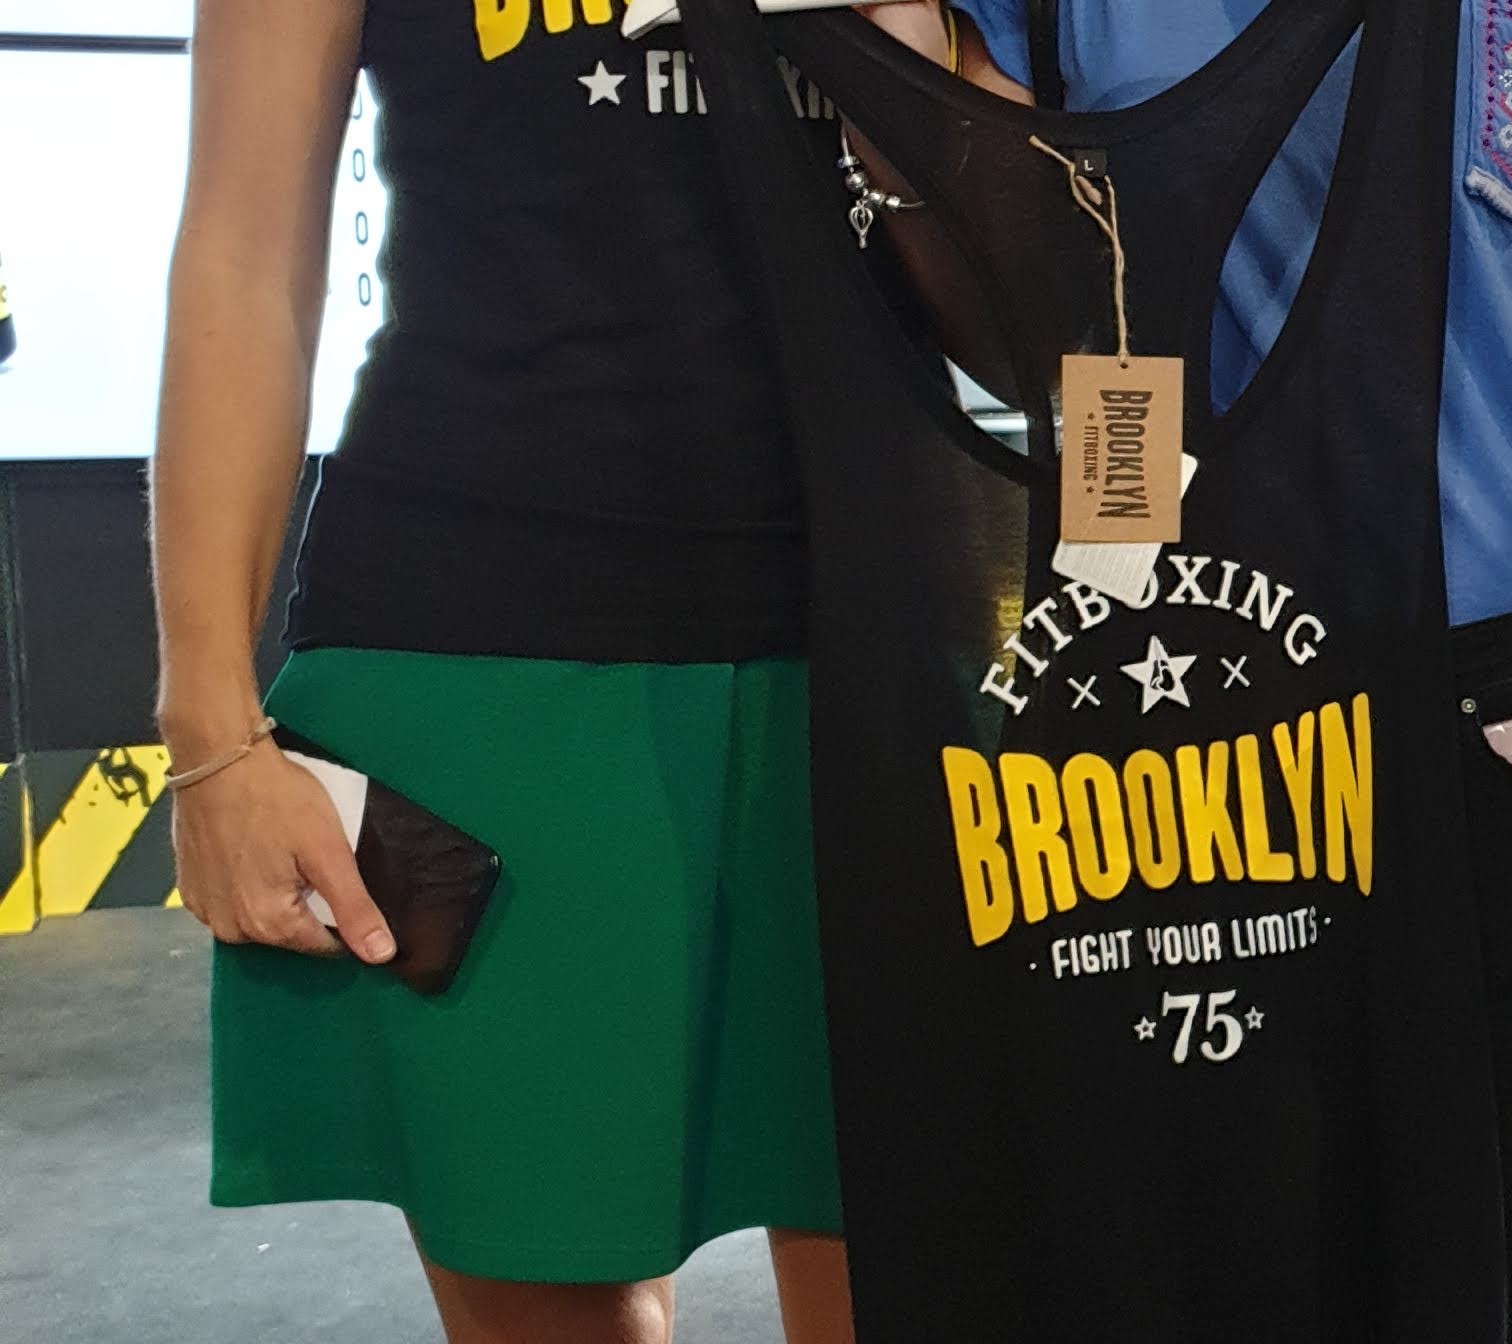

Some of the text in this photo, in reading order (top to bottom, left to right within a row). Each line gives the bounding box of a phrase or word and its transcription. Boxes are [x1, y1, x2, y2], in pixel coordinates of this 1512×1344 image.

[1084, 159, 1094, 172] L
[1083, 425, 1099, 481] FITBOXING
[1097, 389, 1153, 518] BROOKLYN
[942, 692, 1373, 947] BROOKLYN
[1051, 905, 1318, 980] FIGHT YOUR LIMITS
[1161, 988, 1244, 1064] 75
